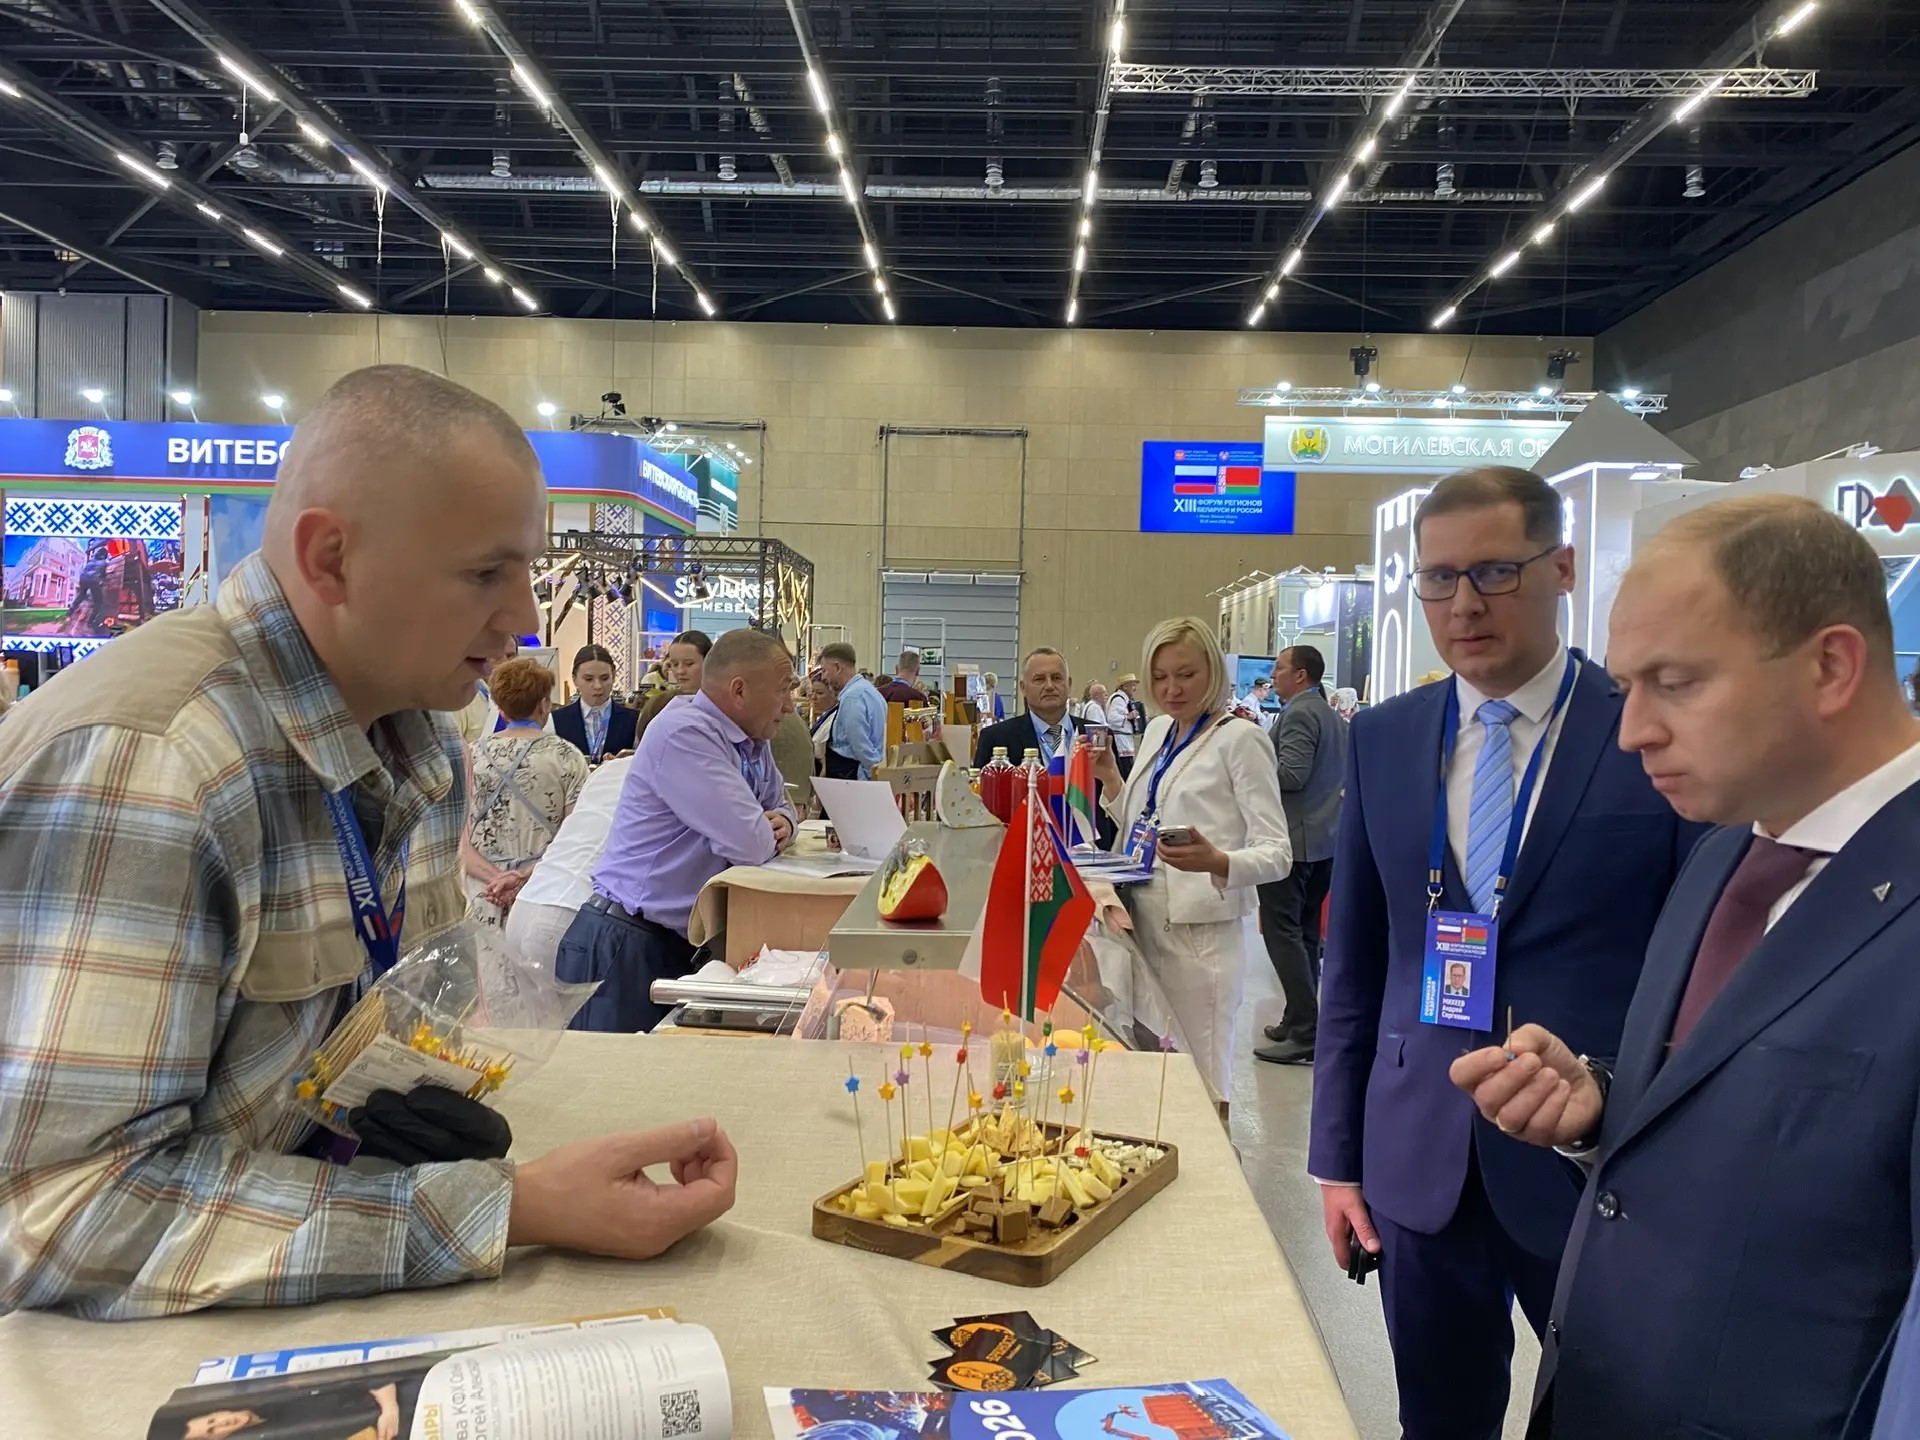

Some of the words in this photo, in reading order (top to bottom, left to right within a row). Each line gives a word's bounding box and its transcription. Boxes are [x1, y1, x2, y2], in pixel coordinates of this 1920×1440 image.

[1343, 435, 1513, 457] МОГИЛЕВСКАЯ
[1173, 499, 1196, 513] XIII
[1198, 499, 1223, 507] ФОРУМ
[702, 602, 750, 612] MEBEL
[350, 876, 377, 910] XIII
